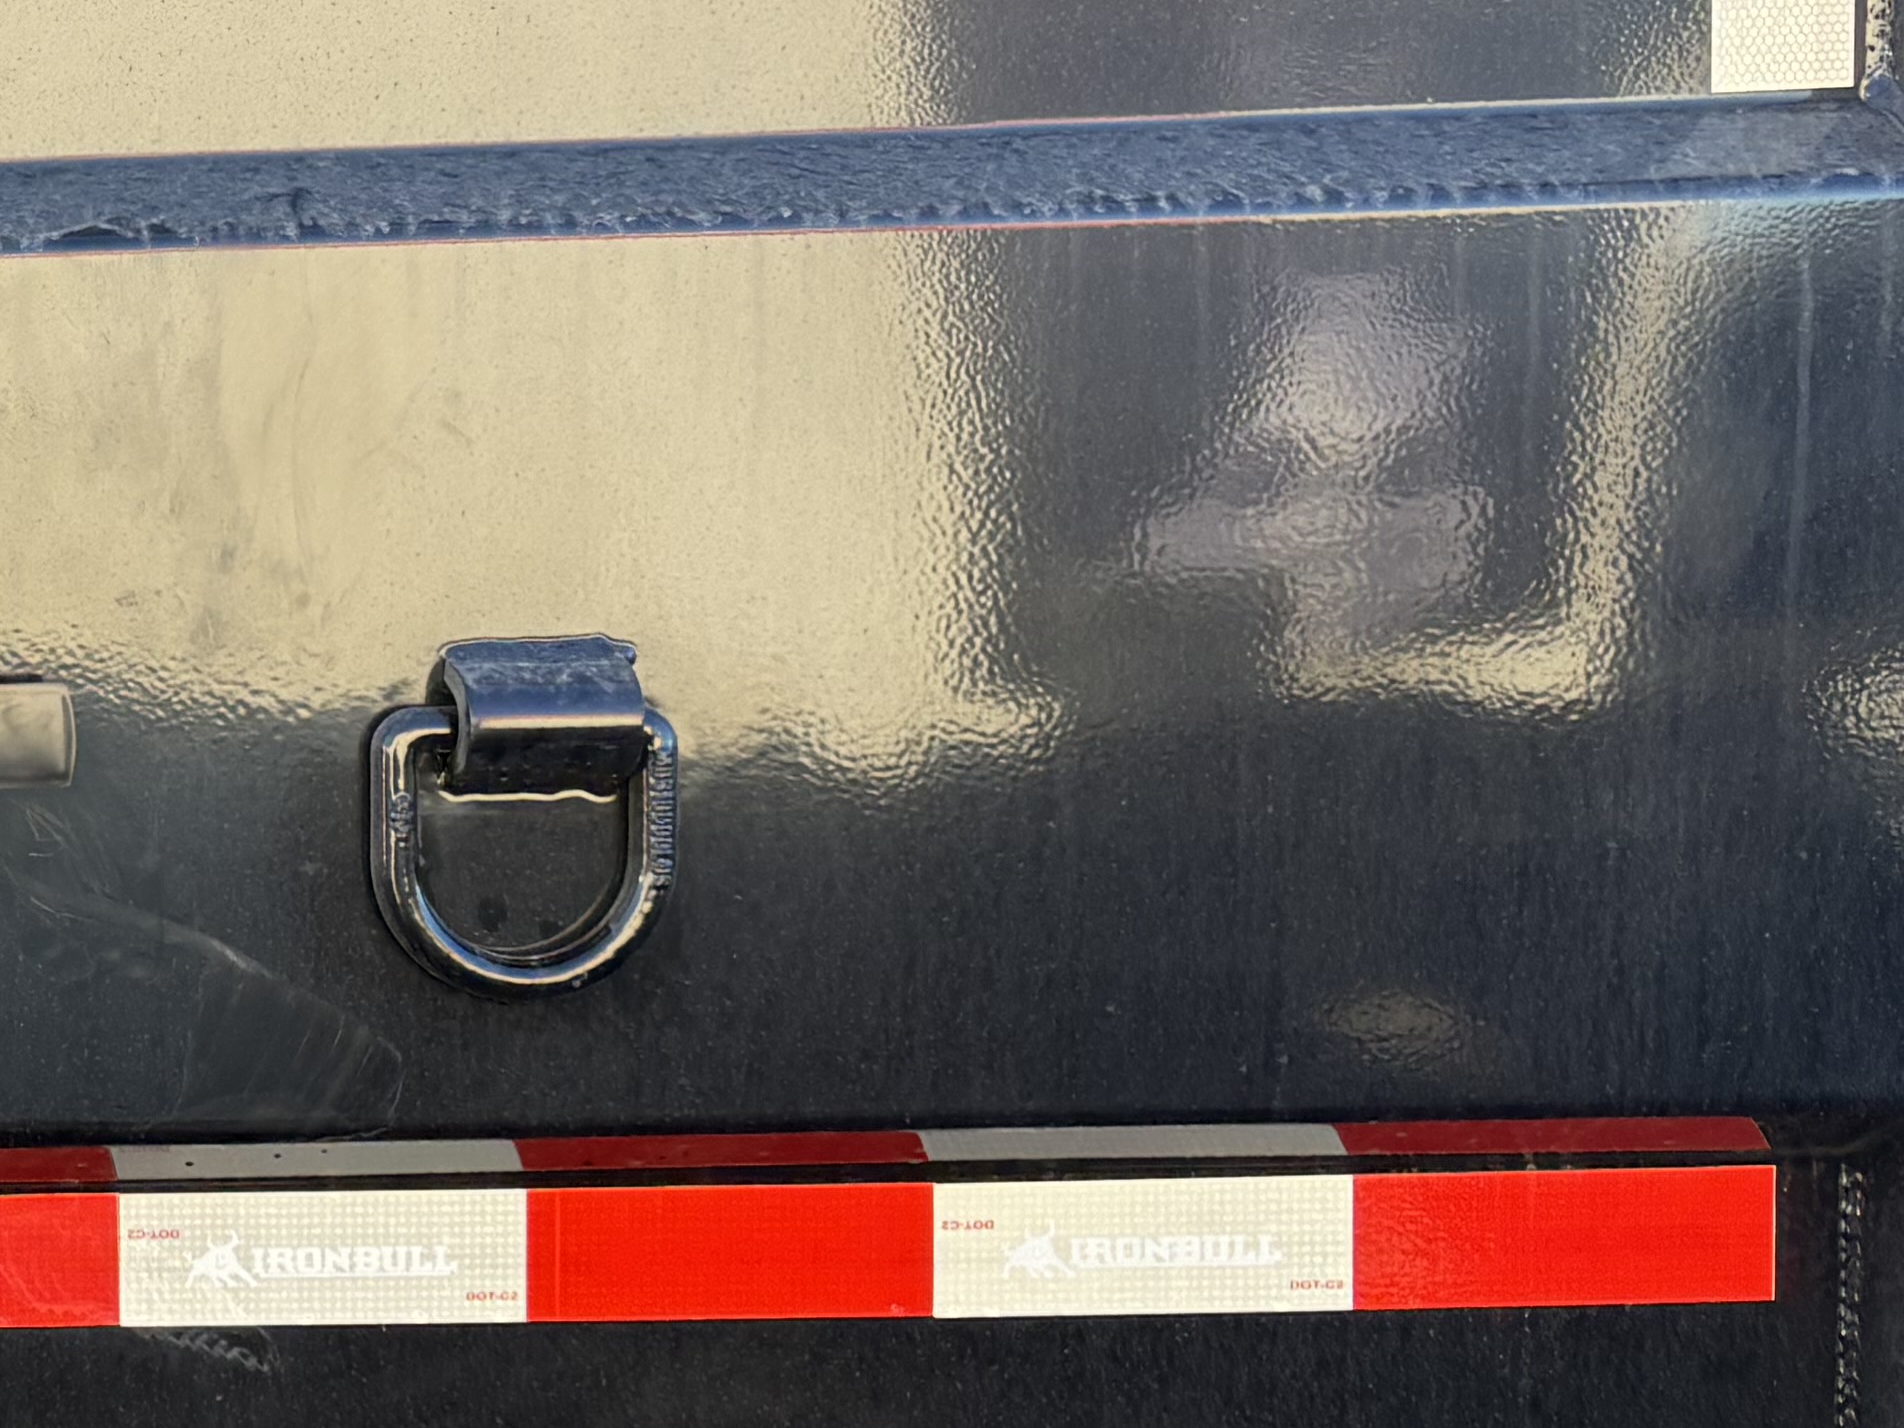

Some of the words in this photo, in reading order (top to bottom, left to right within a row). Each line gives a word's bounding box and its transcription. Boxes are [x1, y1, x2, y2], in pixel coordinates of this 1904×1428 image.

[941, 1220, 994, 1230] DOT-C2
[128, 1229, 180, 1239] DOT-C2
[1070, 1234, 1282, 1264] IRONBULL
[251, 1245, 457, 1274] IRONBULL
[1290, 1280, 1344, 1290] DOT-C2
[466, 1291, 518, 1302] DOT-C2
